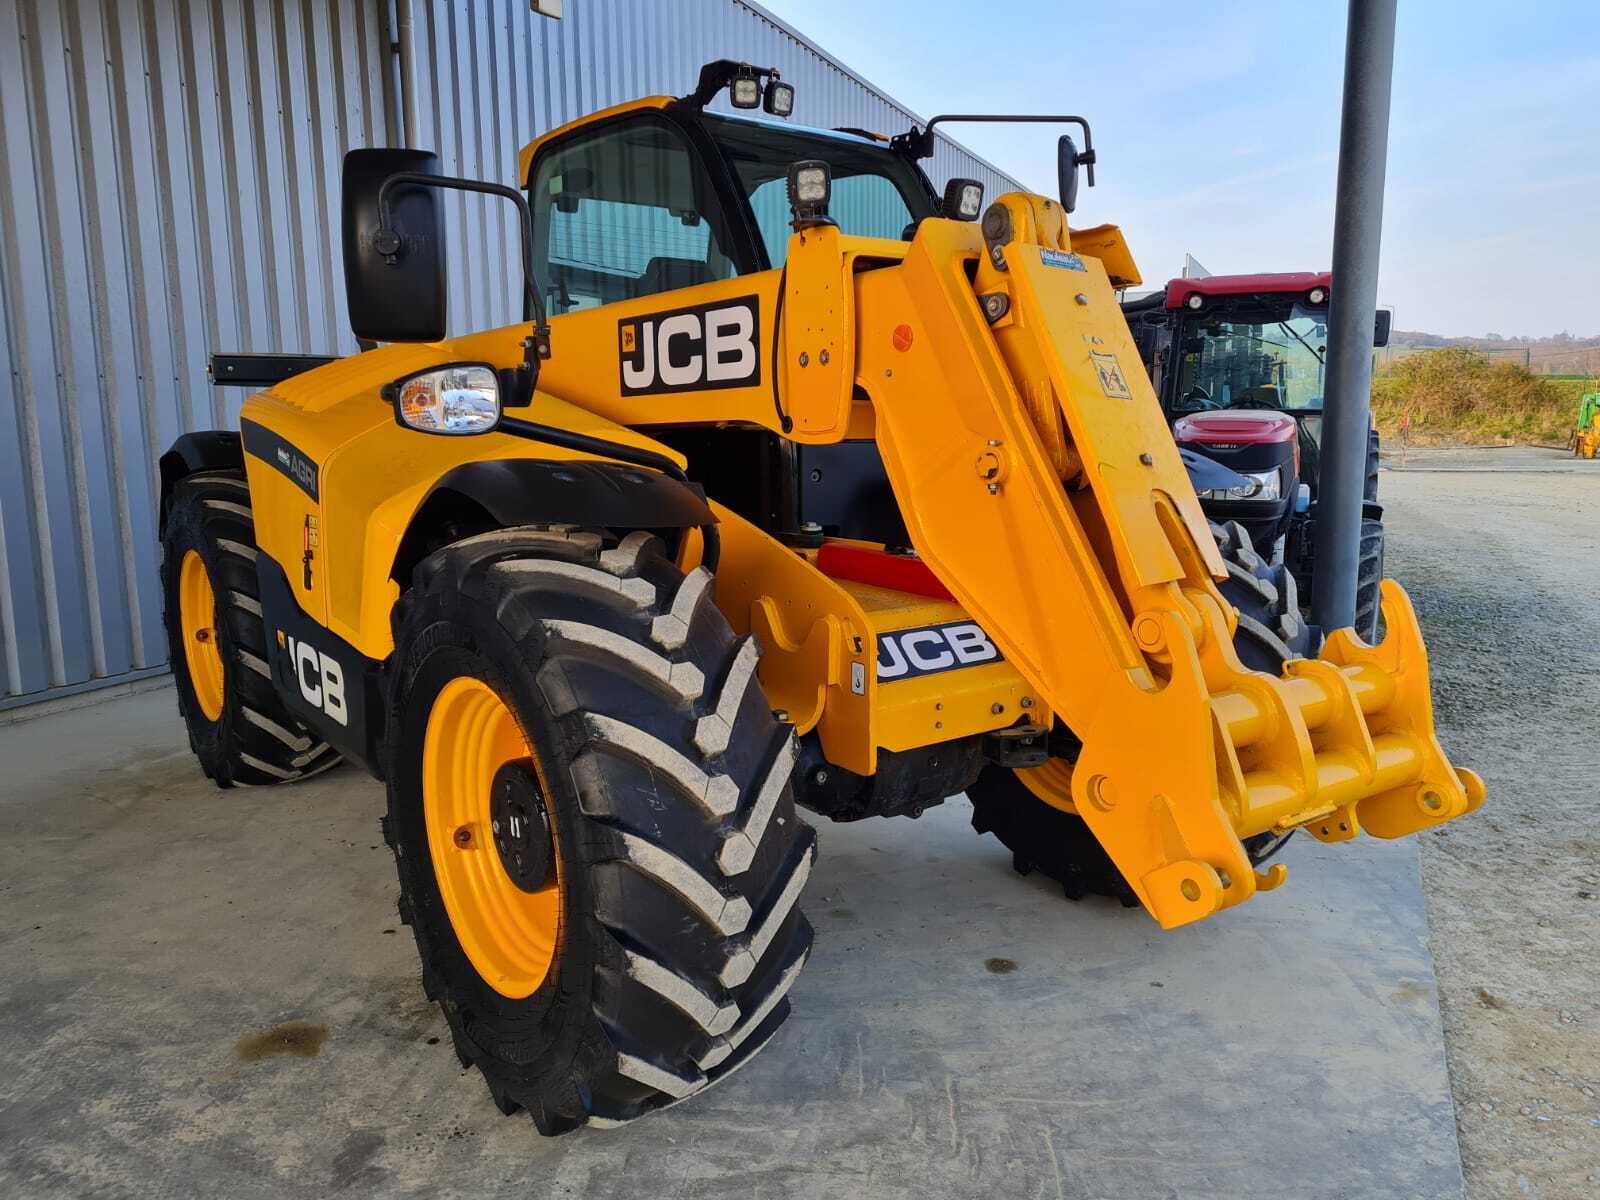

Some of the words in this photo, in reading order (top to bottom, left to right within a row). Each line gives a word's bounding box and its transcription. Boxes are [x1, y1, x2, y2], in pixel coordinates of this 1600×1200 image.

[622, 305, 756, 388] JCB
[290, 454, 316, 493] AGRI
[877, 624, 997, 678] JCB
